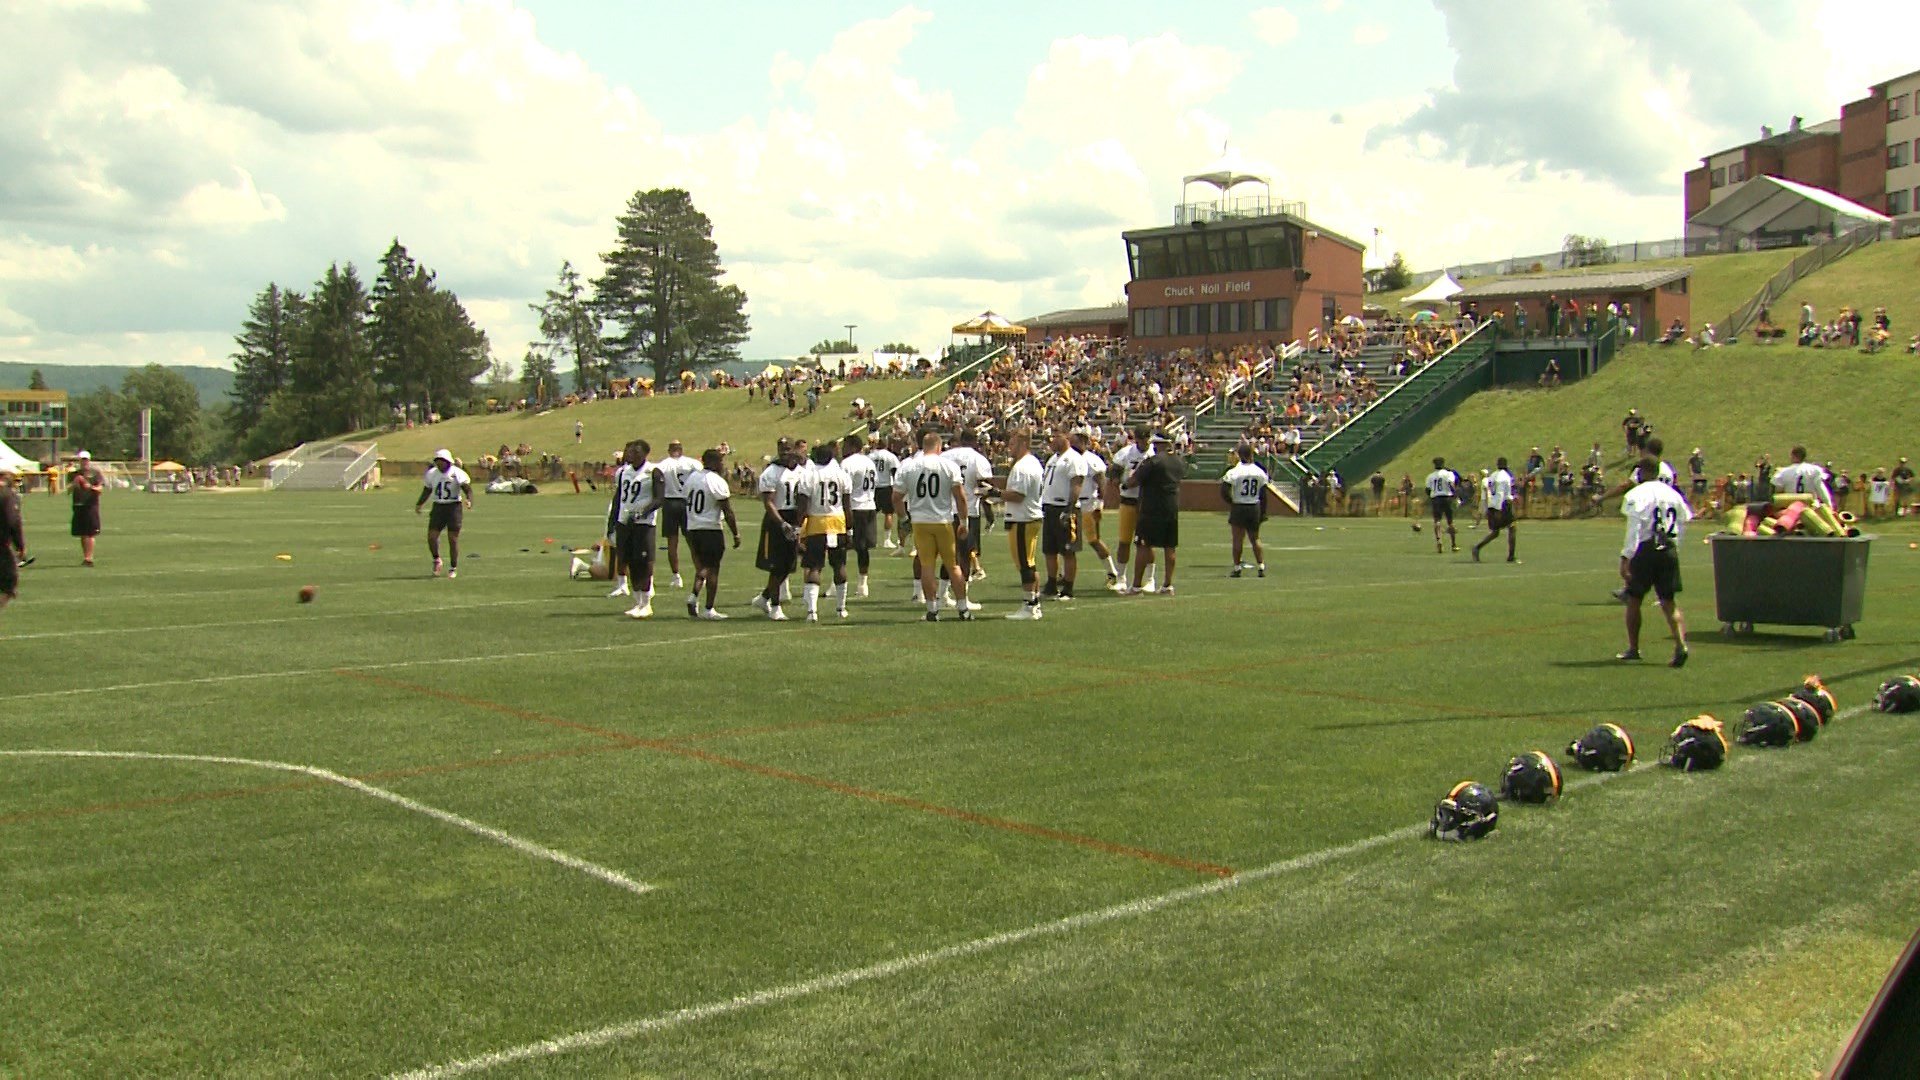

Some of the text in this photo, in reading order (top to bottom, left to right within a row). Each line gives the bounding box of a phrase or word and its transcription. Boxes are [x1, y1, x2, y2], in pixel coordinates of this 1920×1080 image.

[1164, 281, 1250, 297] Chuck Noll Field
[434, 481, 451, 500] 45
[622, 479, 641, 504] 39
[819, 481, 838, 506] 13
[916, 473, 940, 498] 60
[1241, 479, 1258, 496] 38
[687, 489, 705, 514] 40
